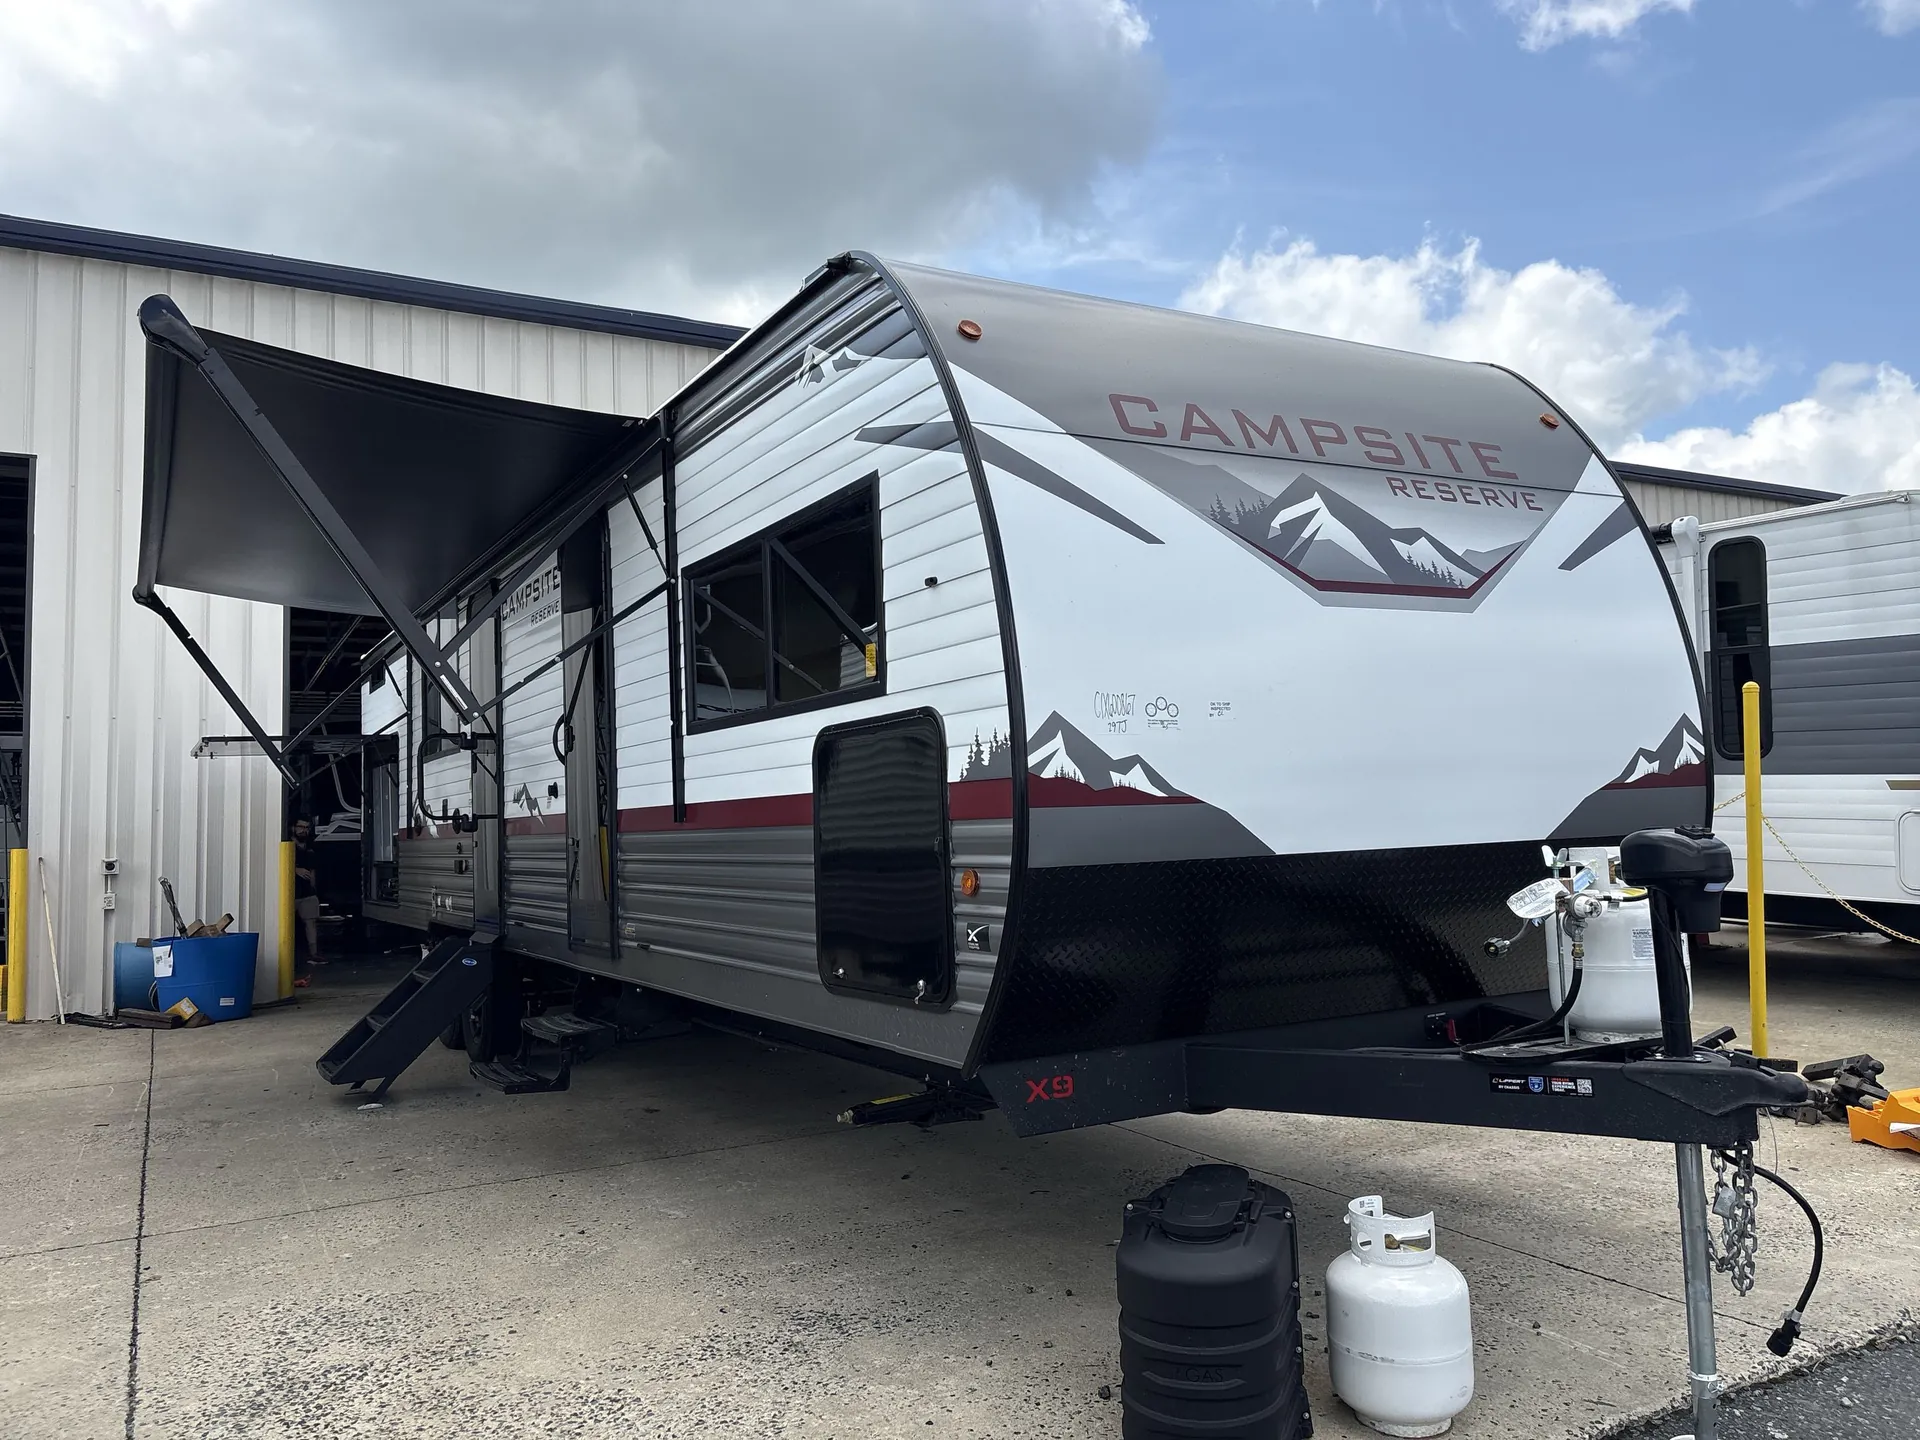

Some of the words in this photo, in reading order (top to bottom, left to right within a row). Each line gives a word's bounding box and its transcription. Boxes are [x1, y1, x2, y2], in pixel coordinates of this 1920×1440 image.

[1108, 393, 1519, 480] CAMPSITE
[1385, 476, 1544, 512] RESERVE
[501, 565, 560, 622] CAMPSITE
[530, 600, 560, 627] RESERVE
[1025, 1075, 1074, 1103] X9
[1185, 1368, 1224, 1382] GAS
